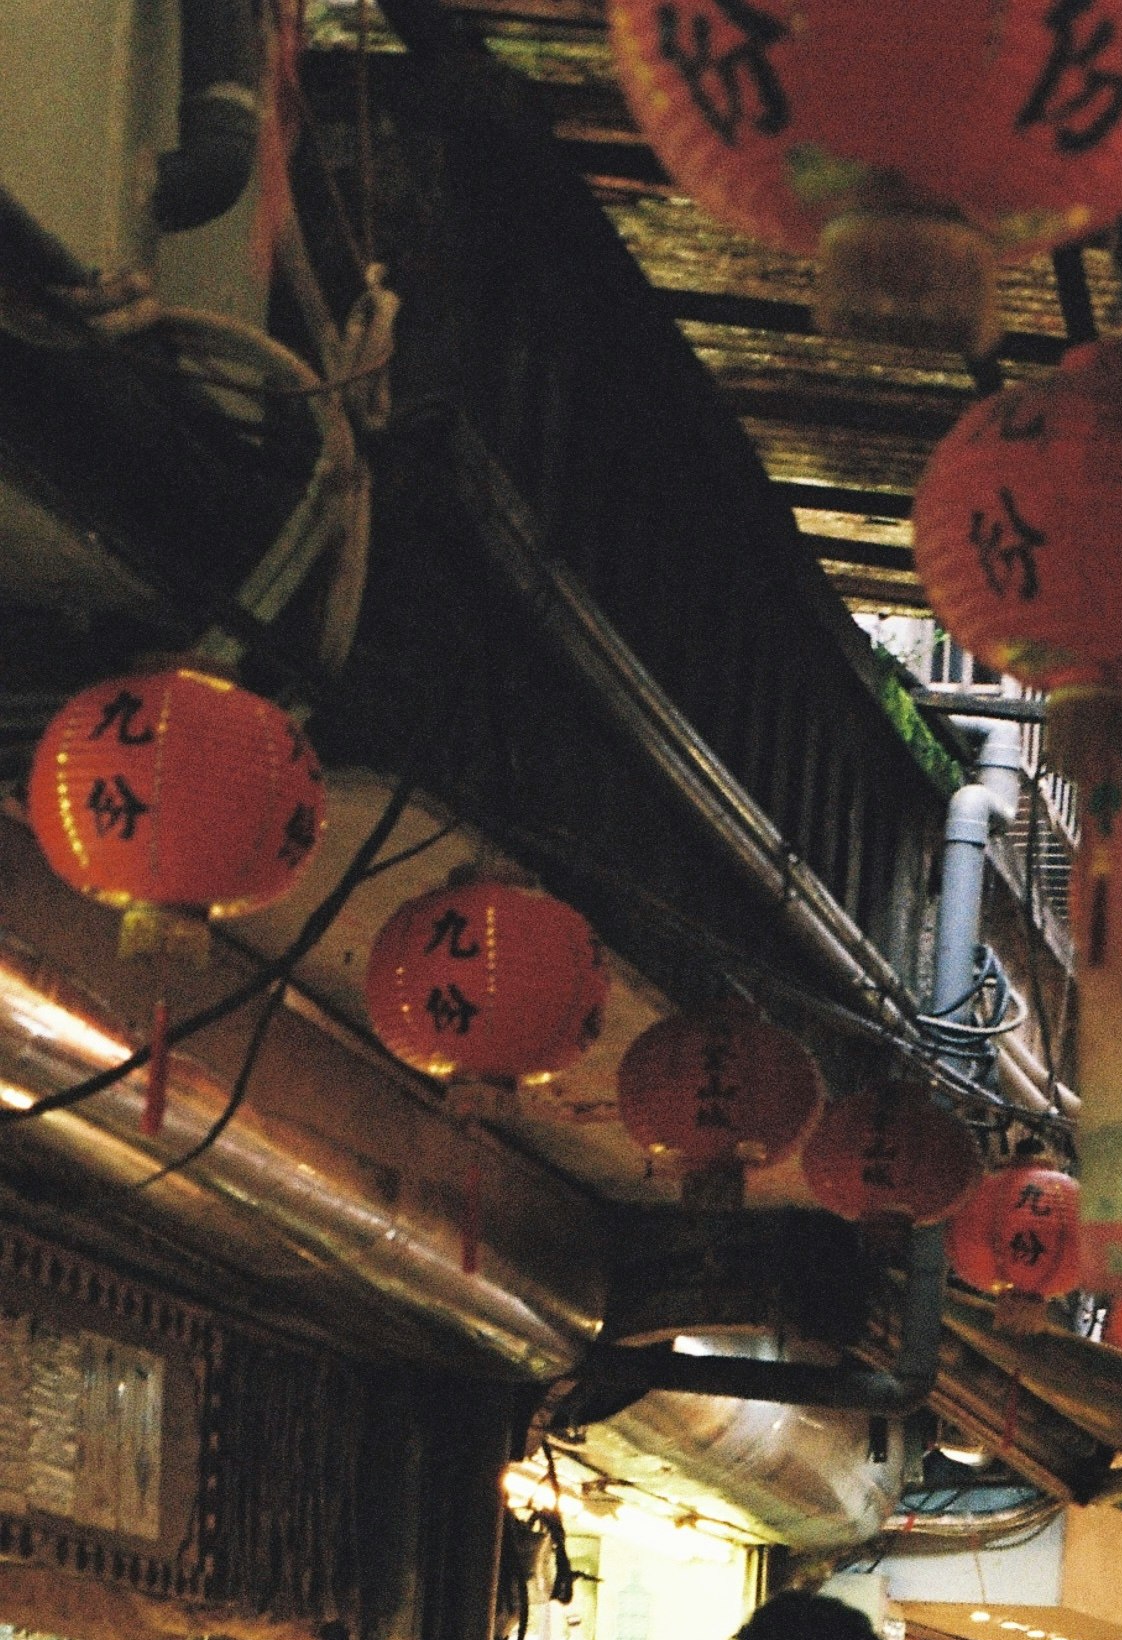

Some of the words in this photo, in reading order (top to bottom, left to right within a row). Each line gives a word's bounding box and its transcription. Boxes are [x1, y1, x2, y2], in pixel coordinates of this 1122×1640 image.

[86, 691, 155, 841] 九份
[424, 908, 481, 1036] 九份
[1010, 1183, 1052, 1267] 九份
